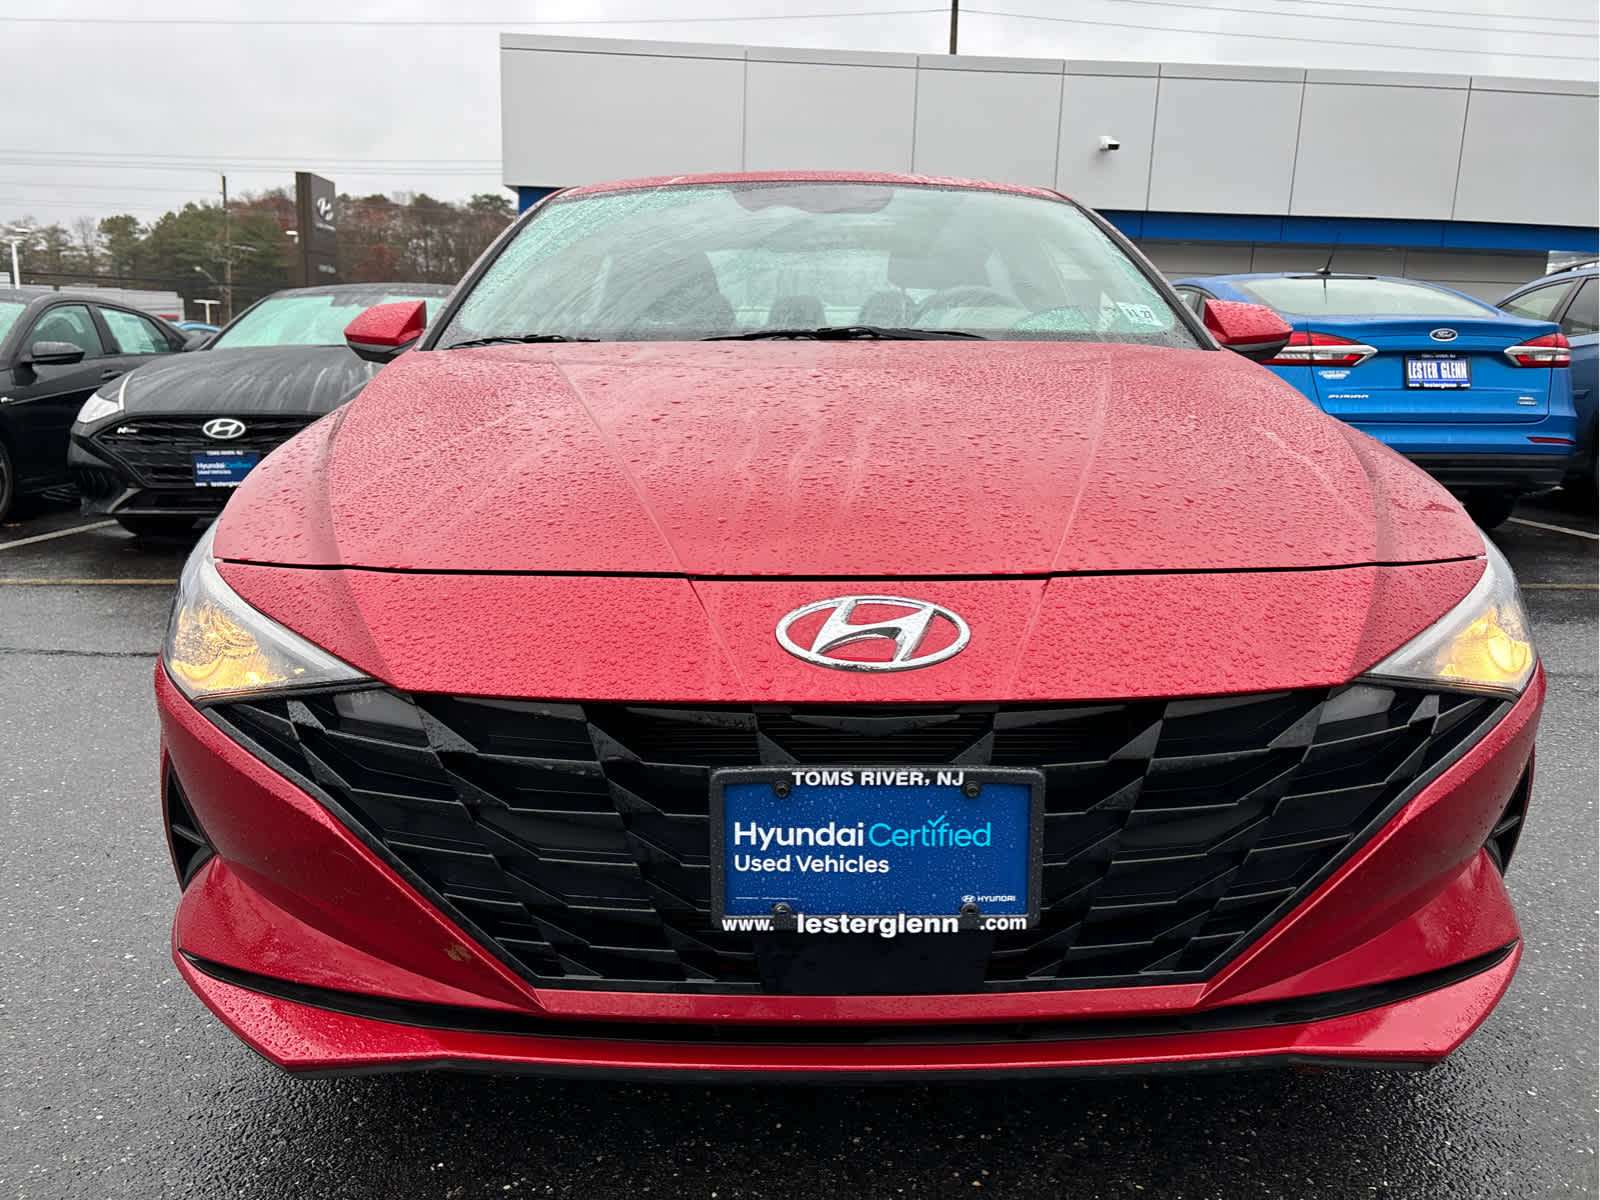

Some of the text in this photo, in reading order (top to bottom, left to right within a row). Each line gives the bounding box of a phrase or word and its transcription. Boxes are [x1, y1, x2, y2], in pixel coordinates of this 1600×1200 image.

[1408, 361, 1467, 379] LESTER GLENN
[792, 771, 964, 786] TOMS RIVER, NJ
[734, 815, 992, 851] Hyundai Certified
[734, 854, 890, 873] Used Vehicles
[722, 913, 1027, 938] www. lesterglenn .com
